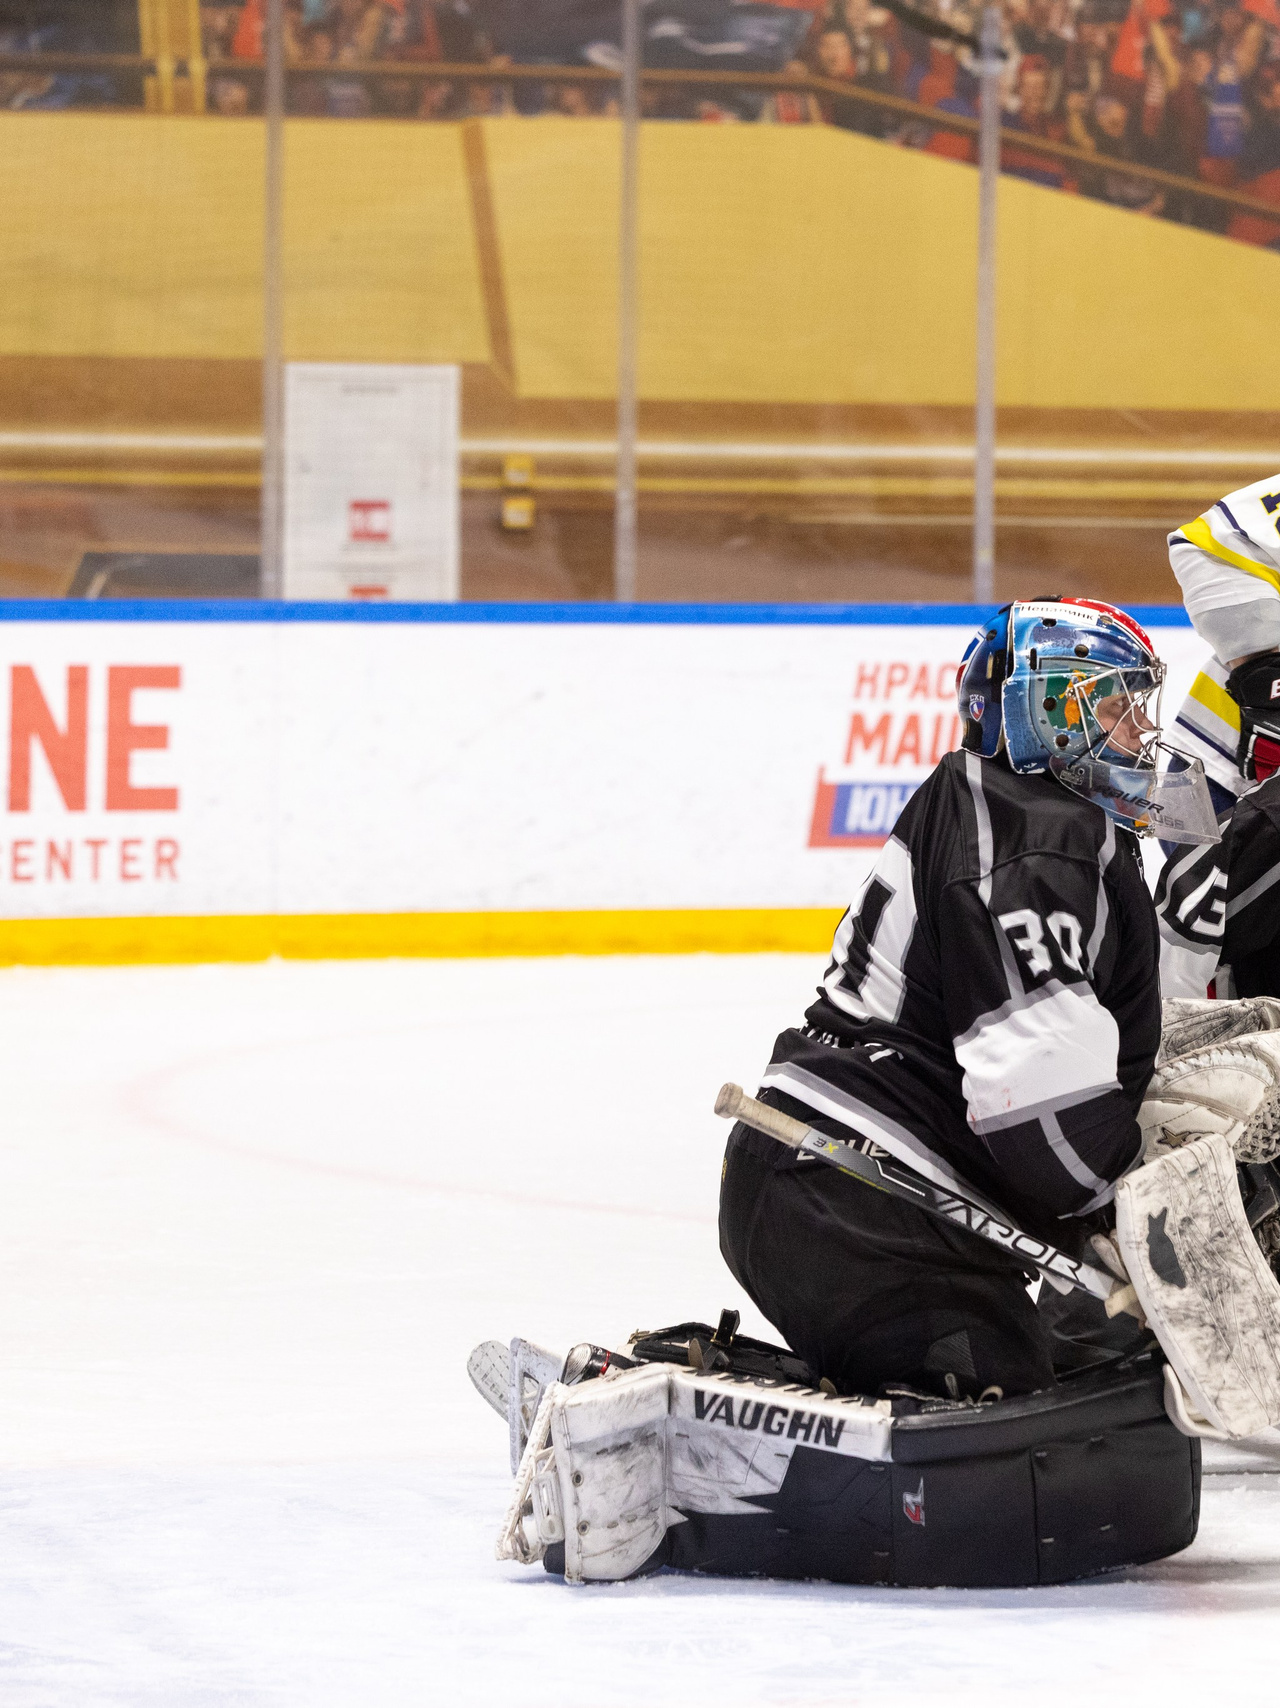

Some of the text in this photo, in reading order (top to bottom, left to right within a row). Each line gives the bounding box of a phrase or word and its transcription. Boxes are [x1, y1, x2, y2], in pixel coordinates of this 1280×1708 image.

[0, 837, 181, 883] ENTER
[997, 908, 1085, 978] 30
[692, 1388, 848, 1449] VAUGHN
